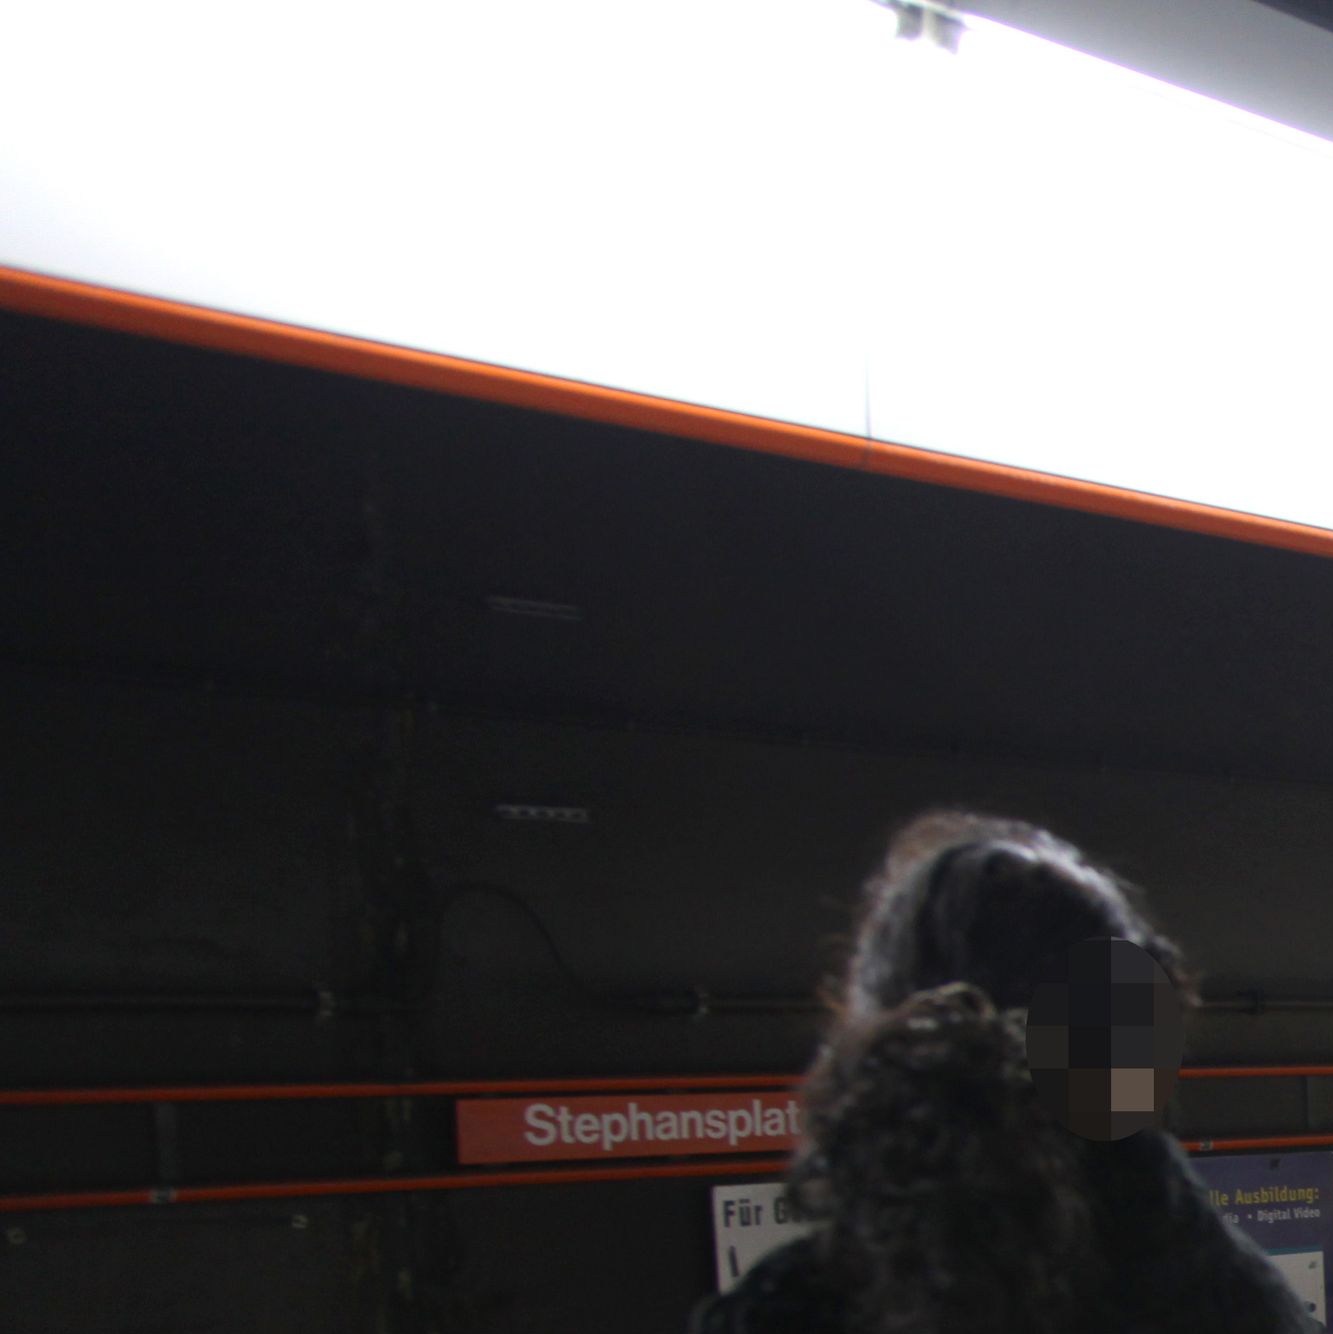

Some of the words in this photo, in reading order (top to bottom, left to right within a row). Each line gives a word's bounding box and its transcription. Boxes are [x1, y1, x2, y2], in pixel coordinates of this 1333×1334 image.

[524, 1098, 801, 1152] Stephansplat
[1235, 1185, 1320, 1206] Ausbildung:
[723, 1198, 763, 1228] Für
[1257, 1208, 1291, 1224] Digital
[1294, 1207, 1321, 1219] Video
